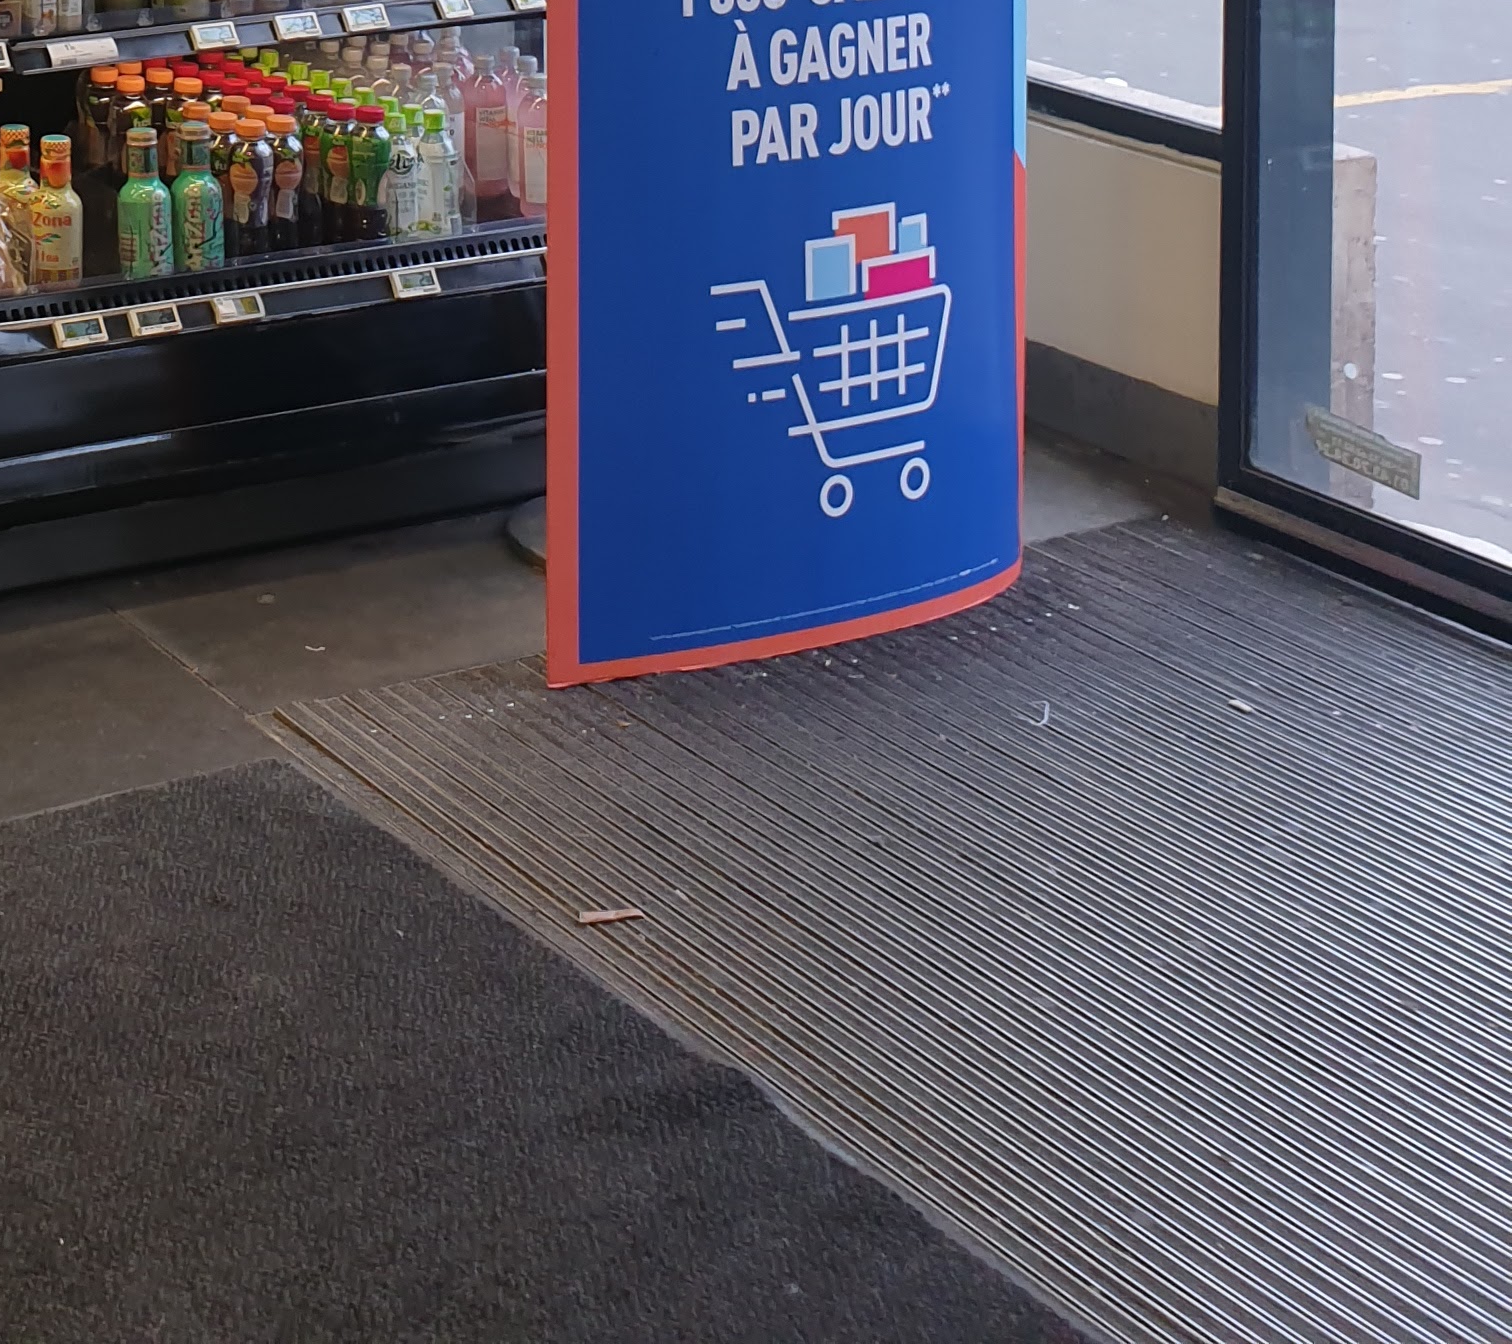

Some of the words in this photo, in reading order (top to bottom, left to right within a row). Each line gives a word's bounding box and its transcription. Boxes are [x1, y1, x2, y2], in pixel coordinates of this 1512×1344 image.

[725, 19, 761, 92] À
[769, 12, 934, 87] GAGNER
[730, 103, 820, 168] PAR
